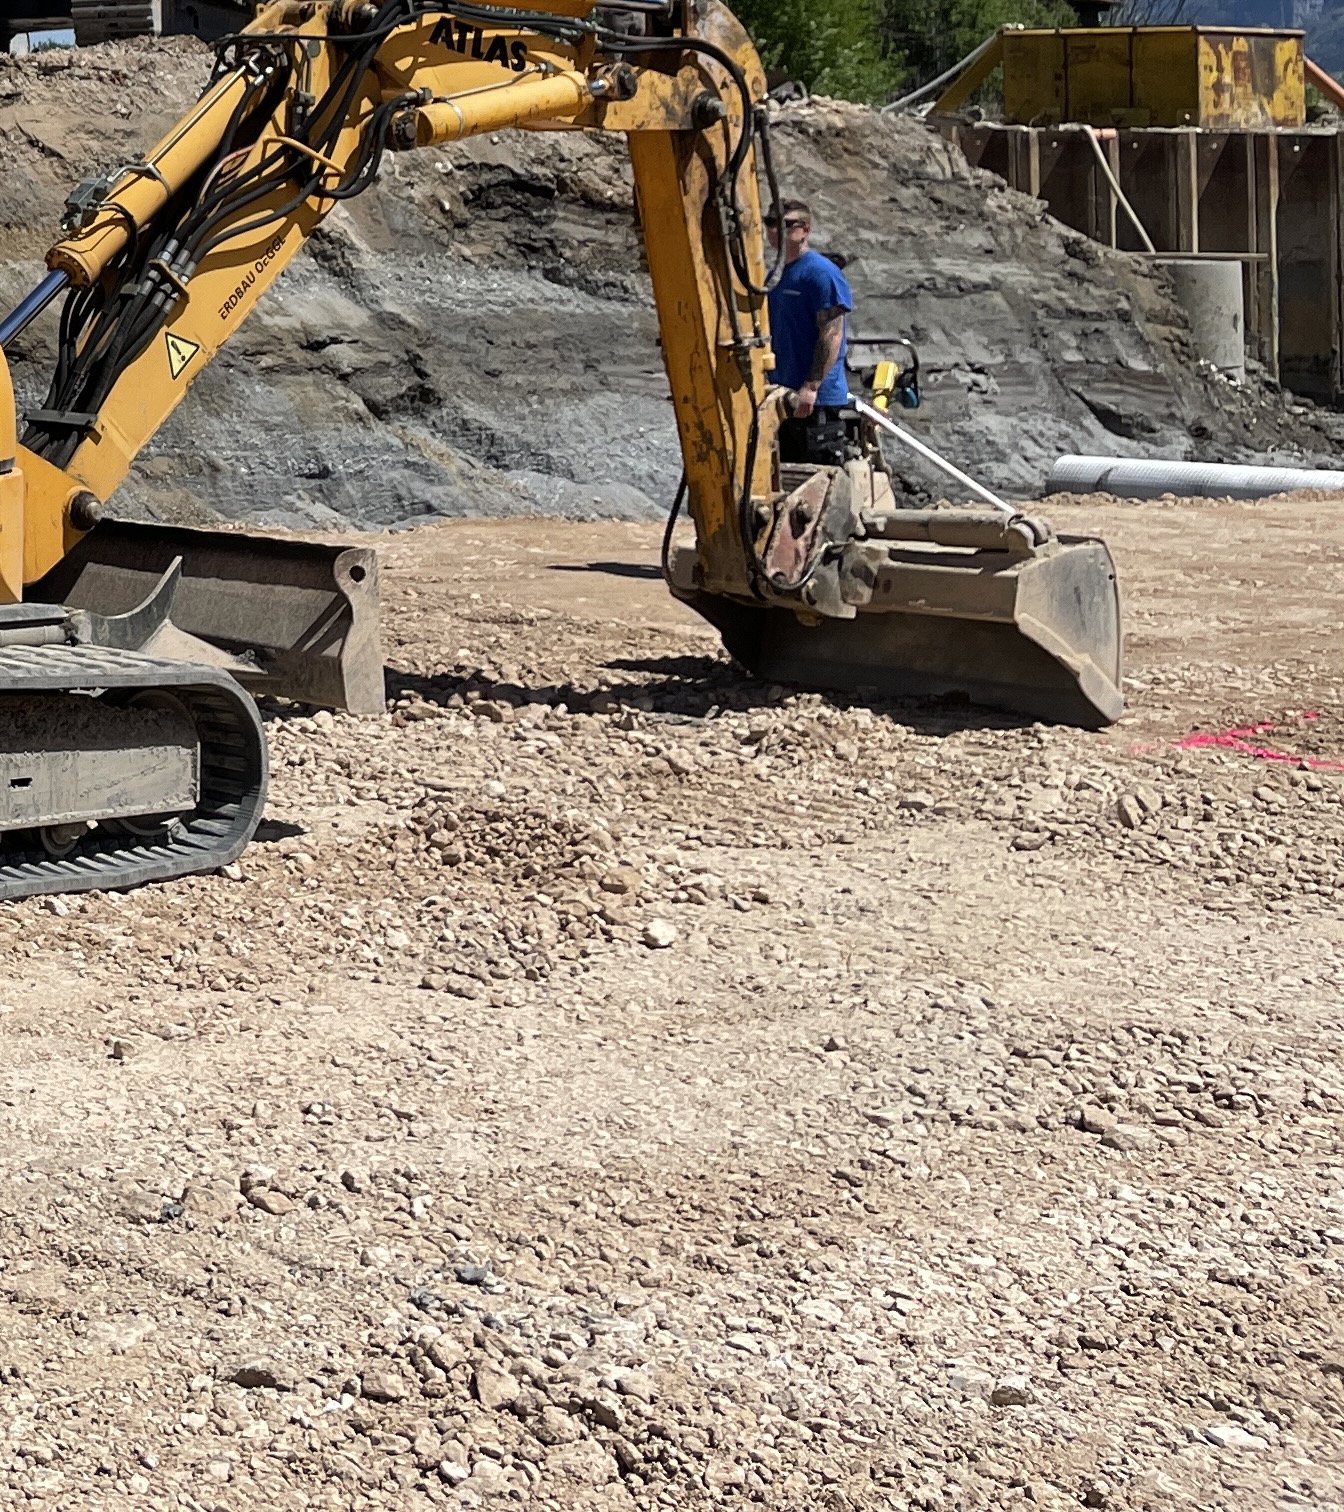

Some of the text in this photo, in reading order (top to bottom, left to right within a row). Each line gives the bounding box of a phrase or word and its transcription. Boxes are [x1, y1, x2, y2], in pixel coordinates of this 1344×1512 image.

[428, 16, 528, 72] ATLAS
[218, 235, 286, 320] ERDBAU OEGGL
